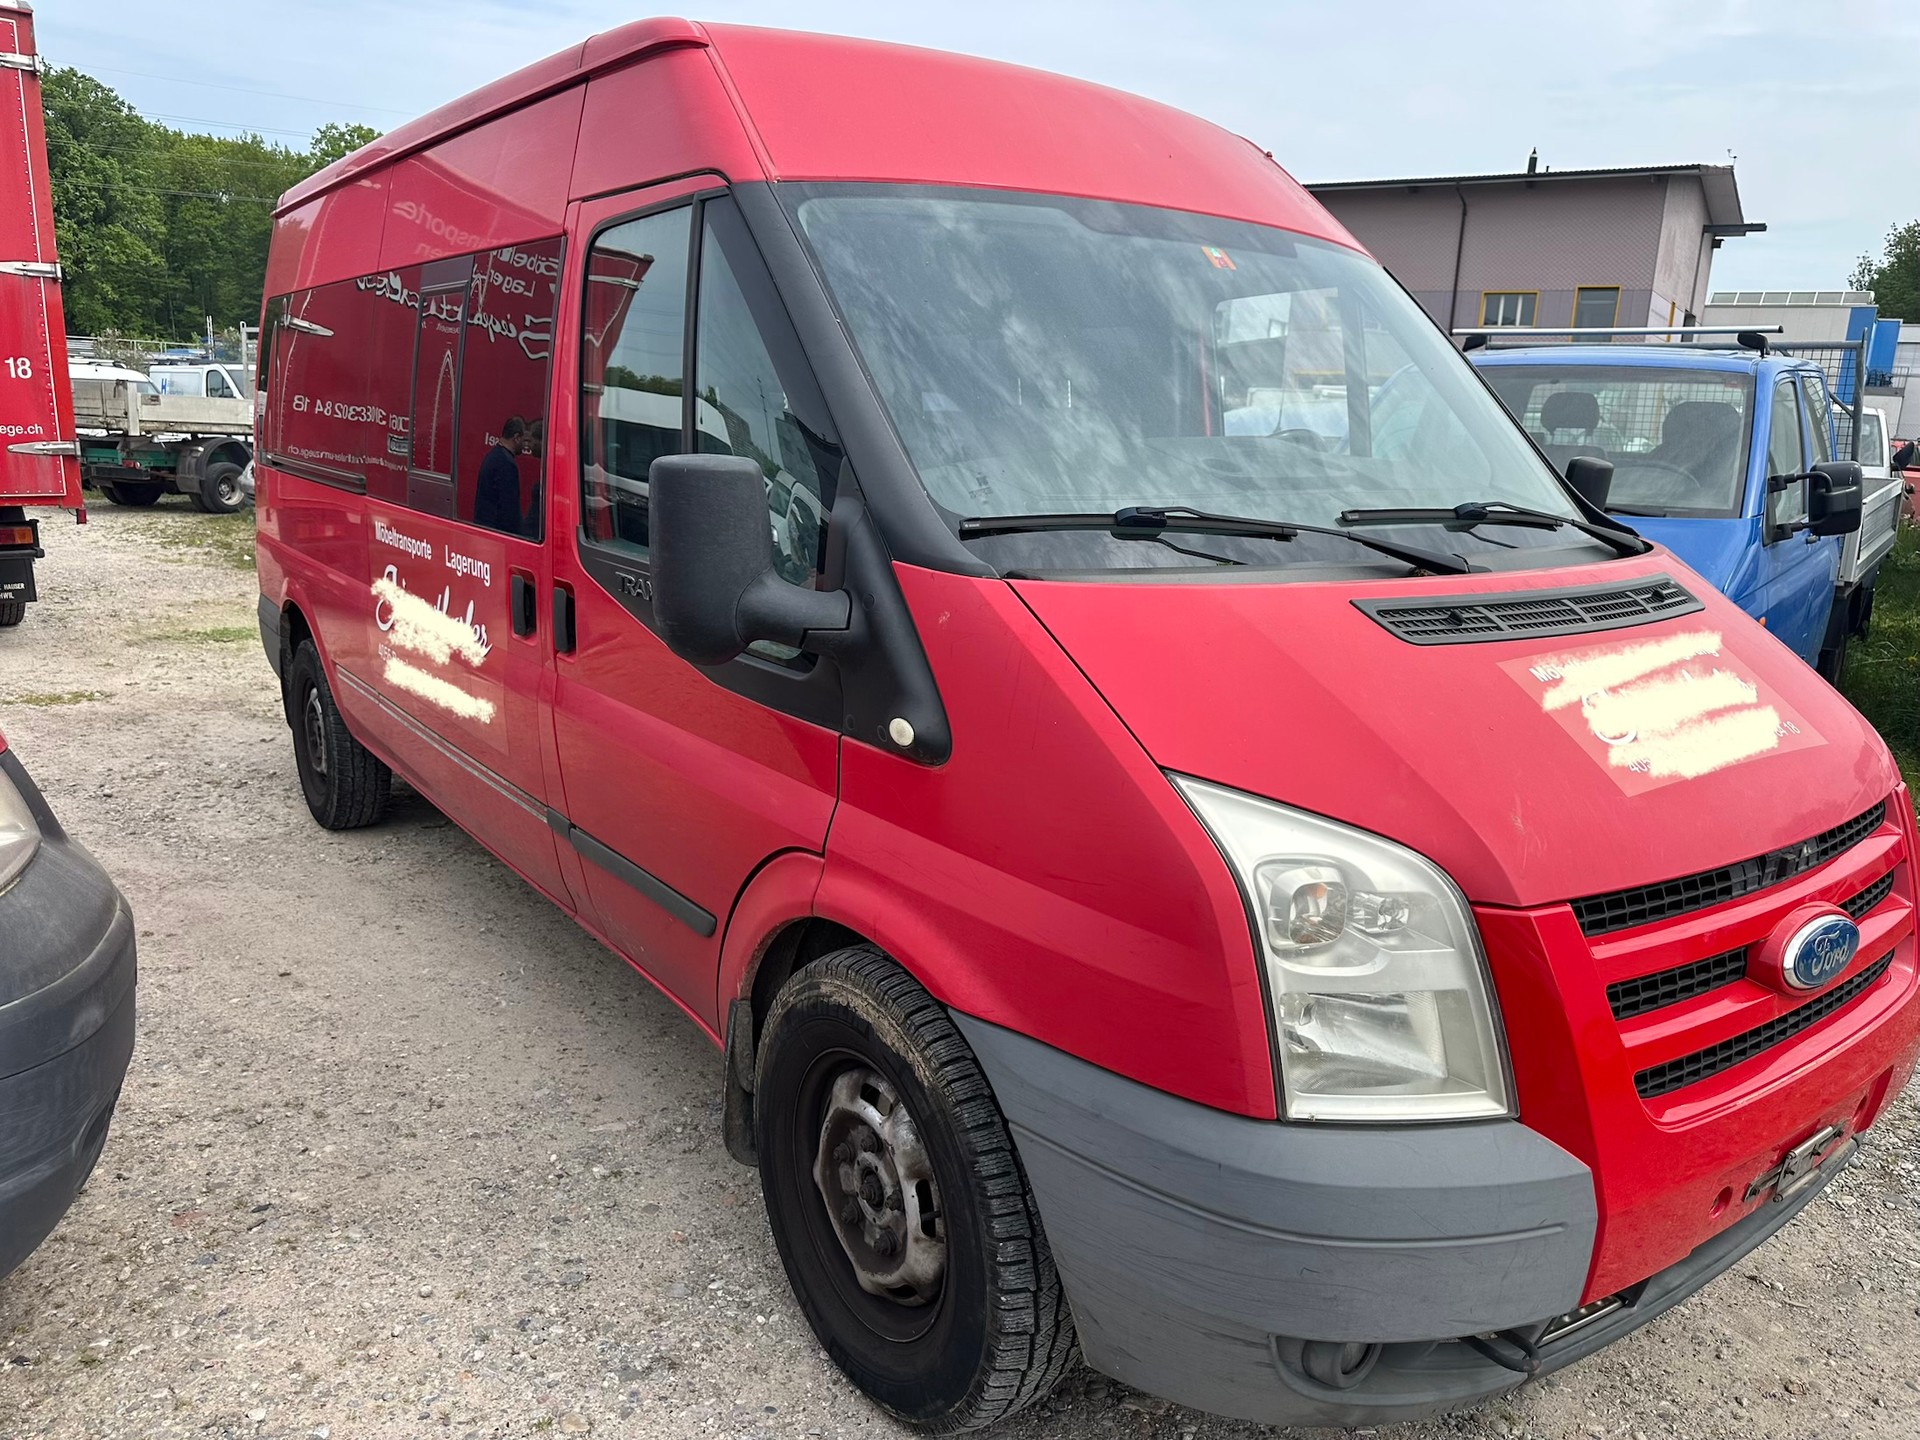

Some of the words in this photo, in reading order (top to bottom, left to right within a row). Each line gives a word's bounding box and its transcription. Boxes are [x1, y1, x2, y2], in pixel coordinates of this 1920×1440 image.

[5, 357, 32, 379] 18
[0, 423, 43, 437] ege.ch
[375, 520, 432, 560] Möbeltransporte
[445, 544, 490, 587] Lagerung
[1783, 720, 1801, 735] 18
[1811, 930, 1850, 976] Ford
